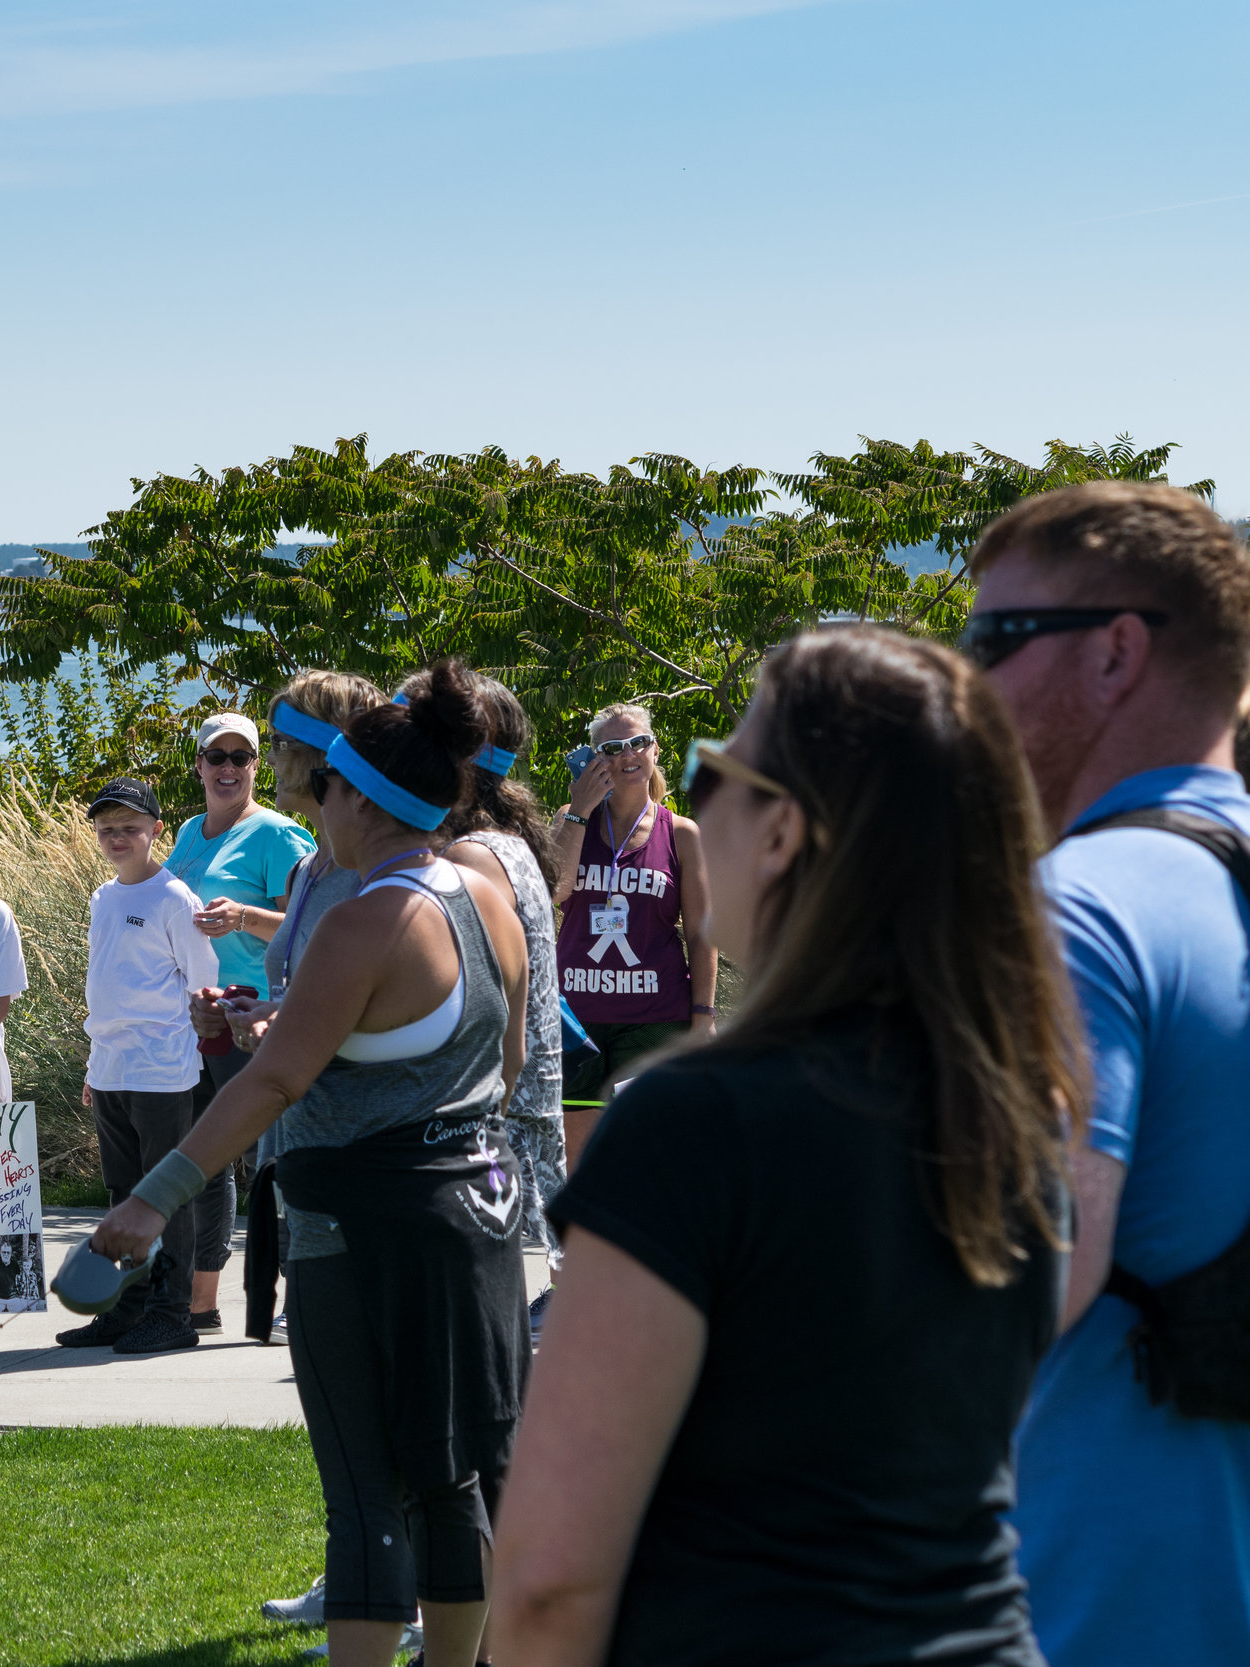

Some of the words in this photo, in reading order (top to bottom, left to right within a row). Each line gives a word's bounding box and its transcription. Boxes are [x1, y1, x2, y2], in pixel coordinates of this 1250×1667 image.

[126, 914, 146, 928] VANS
[563, 967, 659, 994] CRUSHER
[423, 1119, 481, 1145] Cancer
[4, 1164, 35, 1188] HEARTS
[0, 1199, 25, 1224] EVERY
[7, 1212, 34, 1233] DAY
